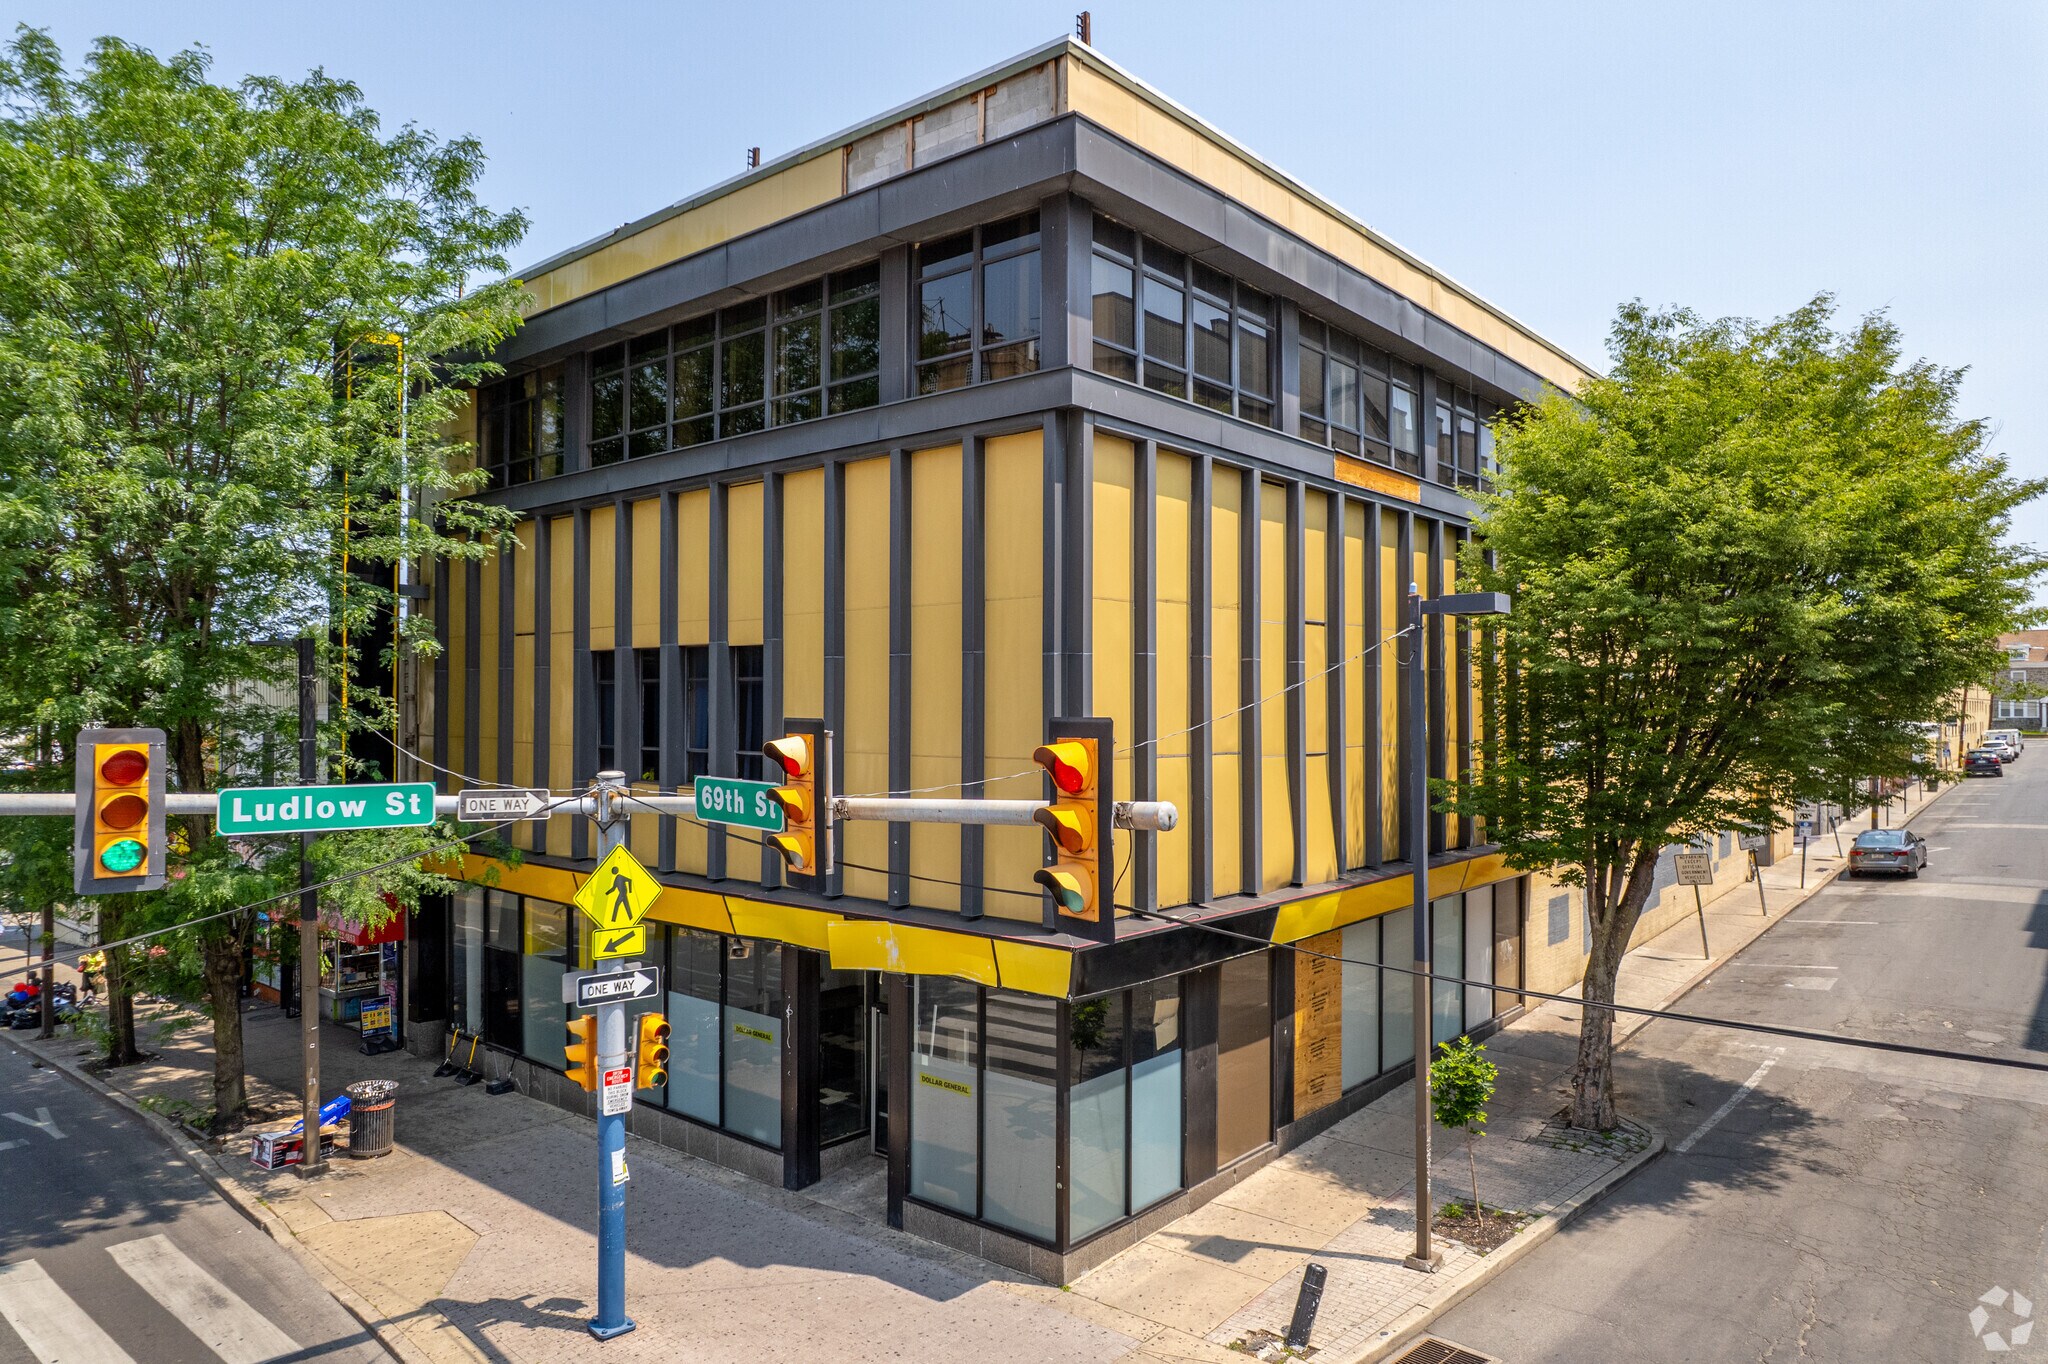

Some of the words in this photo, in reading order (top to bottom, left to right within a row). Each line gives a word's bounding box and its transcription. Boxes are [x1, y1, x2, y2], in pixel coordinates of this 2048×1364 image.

[232, 796, 367, 823] Ludlow
[385, 792, 421, 816] St
[469, 799, 496, 811] ONE
[503, 799, 530, 810] WAY
[702, 785, 744, 814] 69th
[755, 791, 776, 819] St
[587, 984, 608, 996] ONE
[613, 979, 635, 992] WAY
[736, 1026, 752, 1034] DOLLAR
[752, 1030, 771, 1040] GENERAL
[921, 1075, 943, 1087] DOLLAR
[943, 1081, 969, 1094] GENERAL
